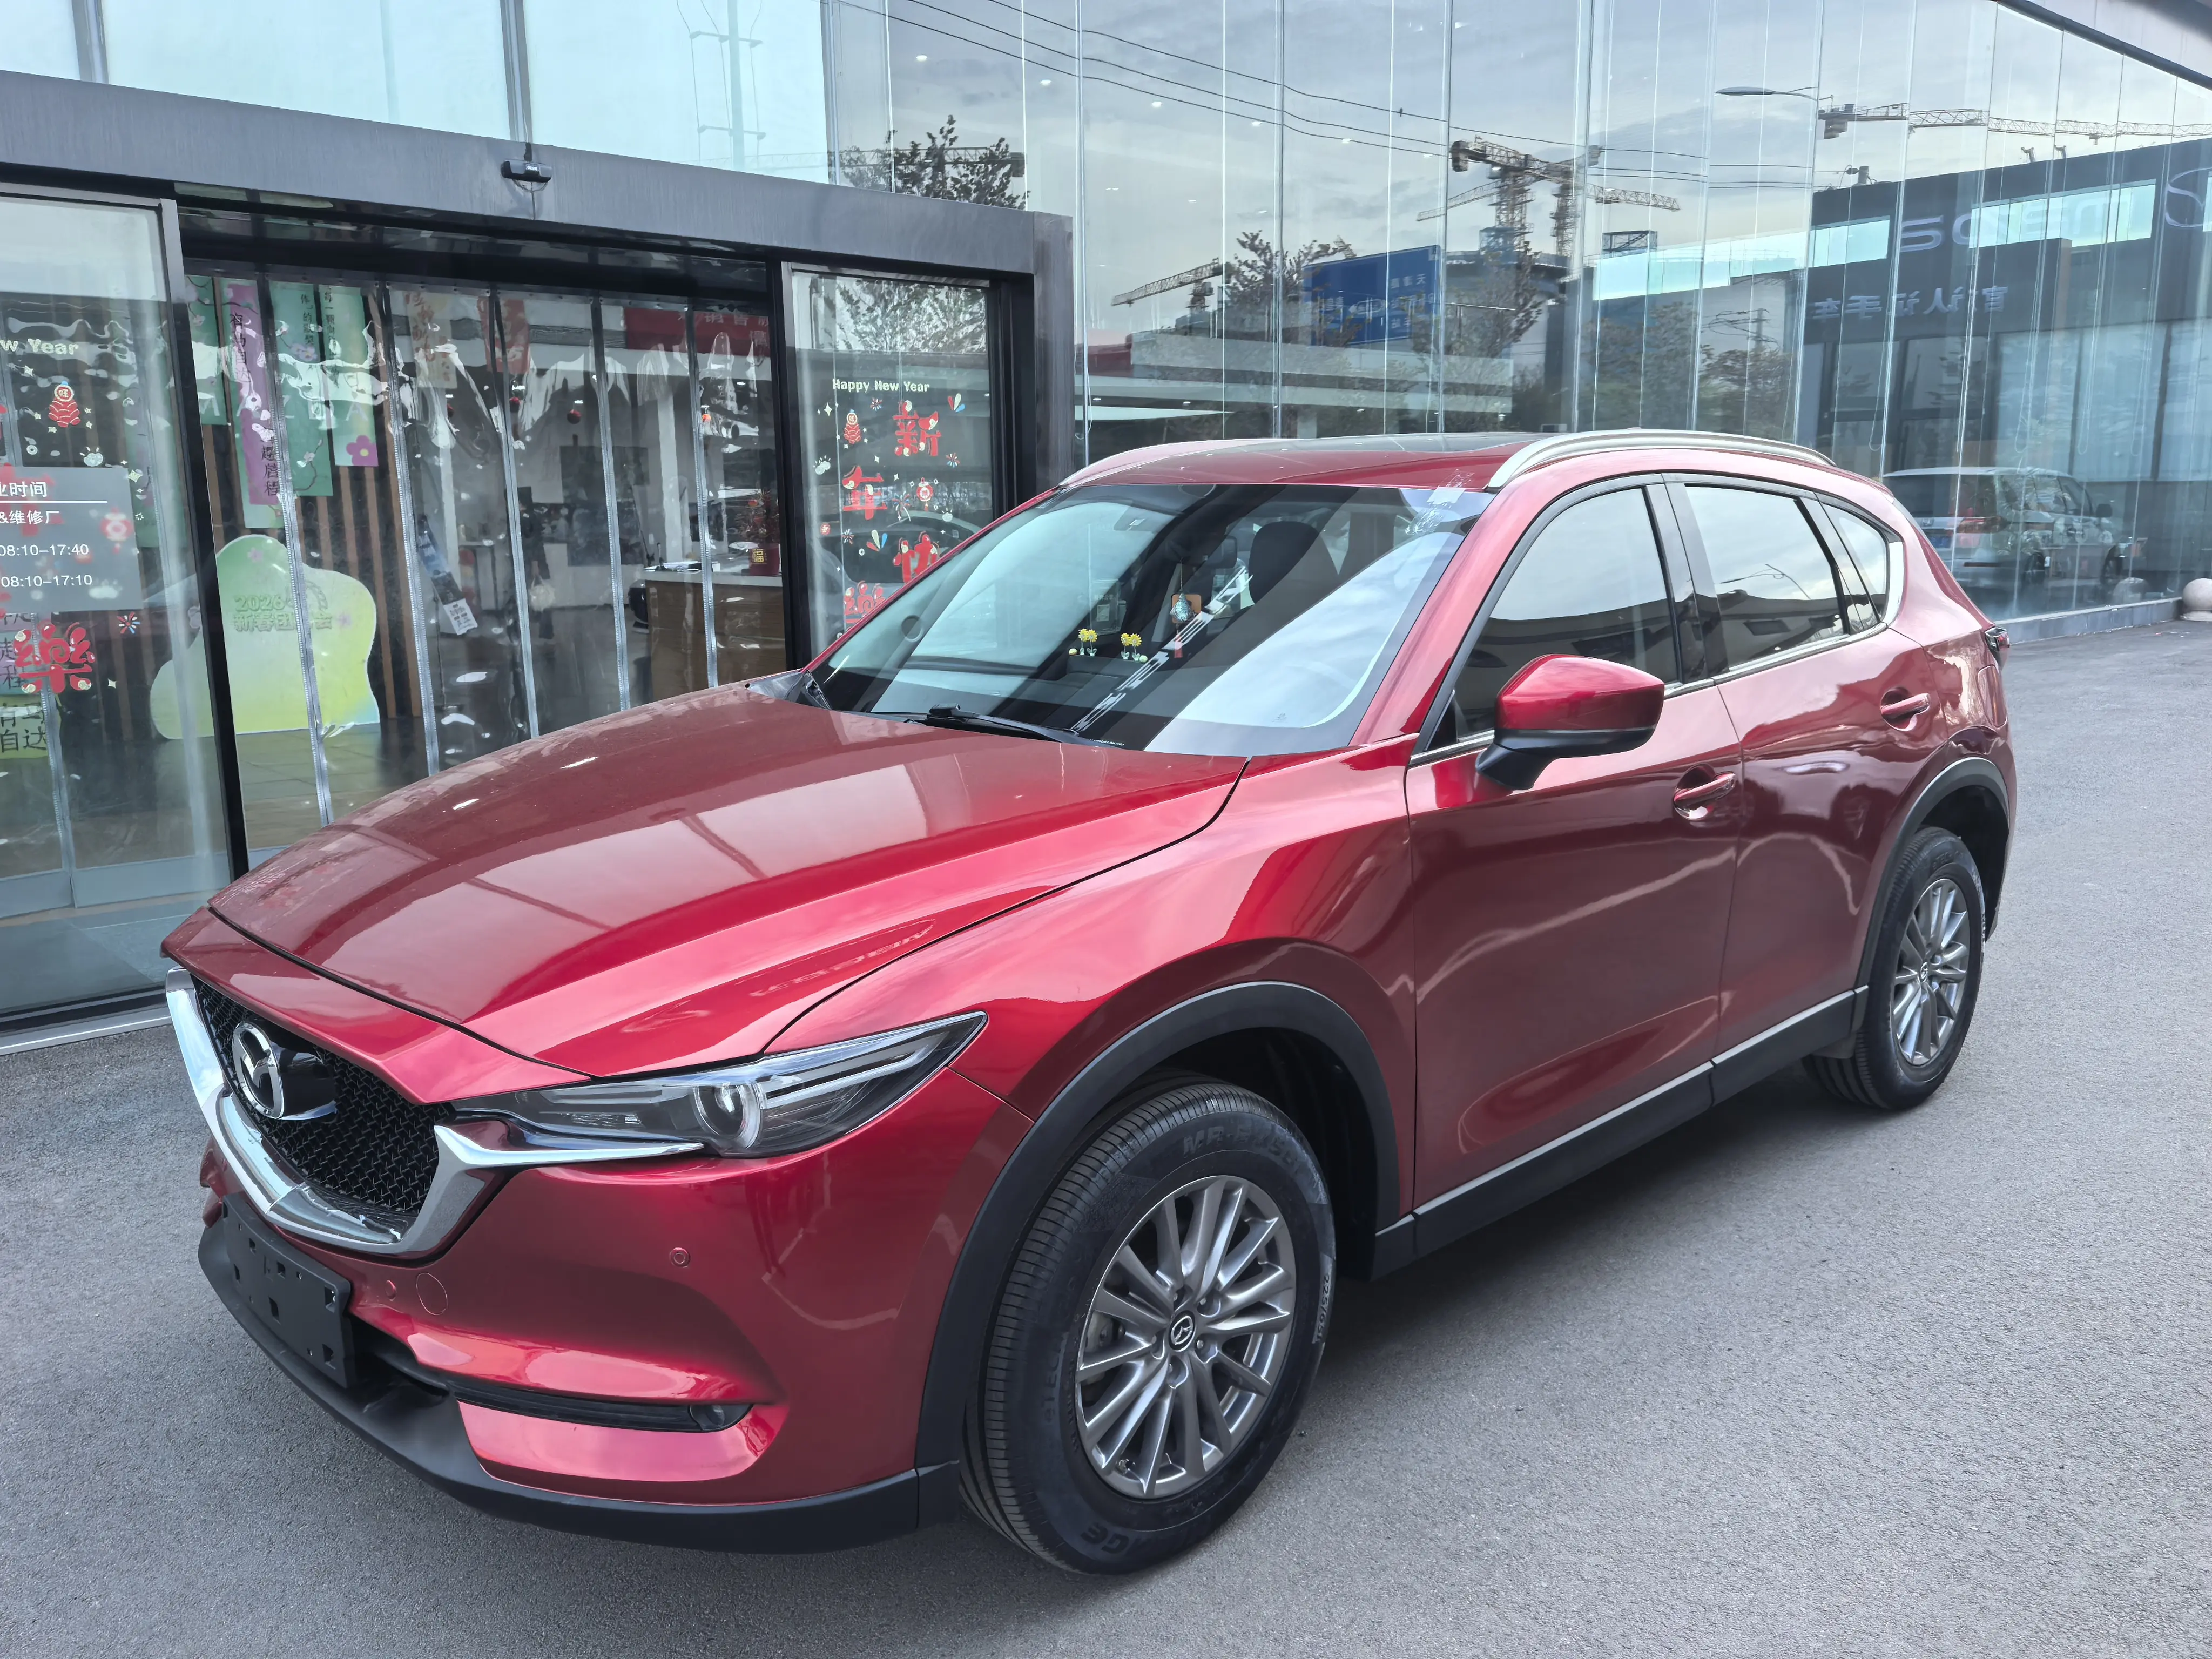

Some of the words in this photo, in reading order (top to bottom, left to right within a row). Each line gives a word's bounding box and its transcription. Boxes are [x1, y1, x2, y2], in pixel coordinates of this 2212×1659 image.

[28, 338, 79, 355] Year
[832, 378, 869, 393] Happy
[874, 380, 899, 392] New
[903, 381, 930, 393] Year
[892, 400, 941, 457] 新
[842, 465, 887, 520] 年
[1, 574, 92, 588] 08:10-17:10
[234, 594, 285, 611] 2026
[233, 611, 333, 632] 新春团会
